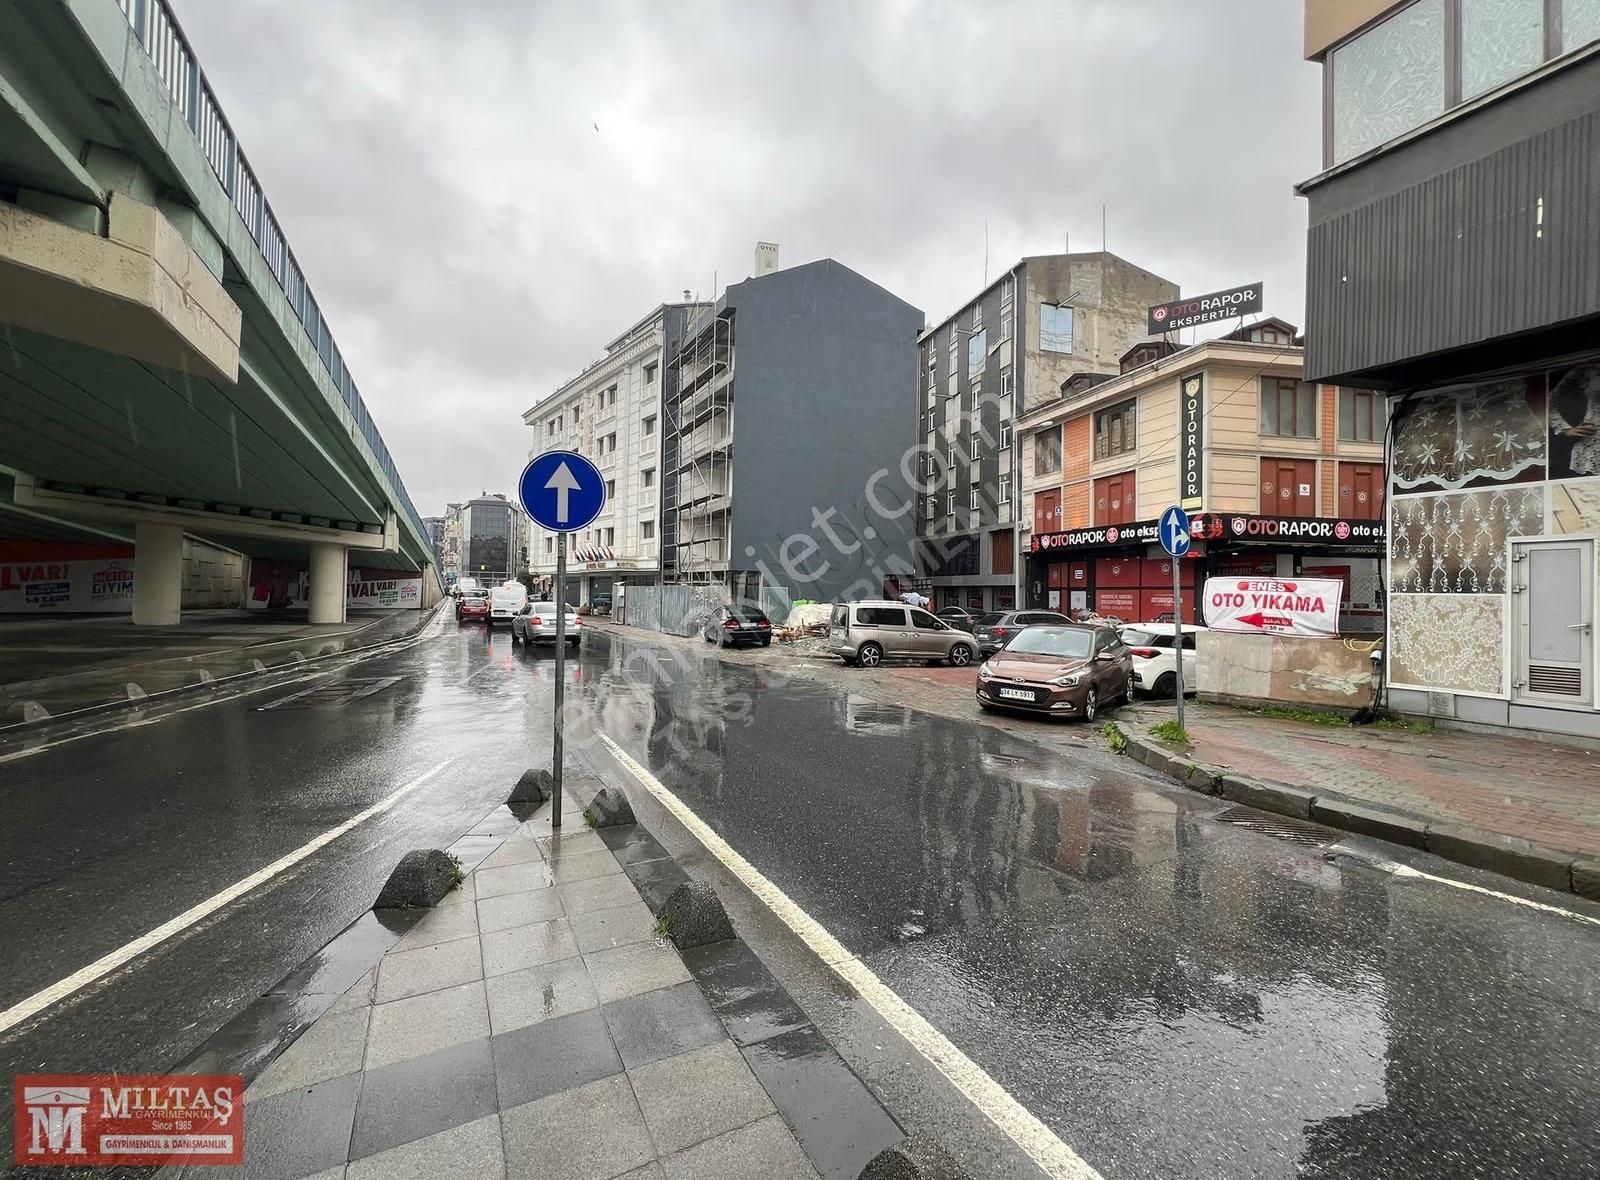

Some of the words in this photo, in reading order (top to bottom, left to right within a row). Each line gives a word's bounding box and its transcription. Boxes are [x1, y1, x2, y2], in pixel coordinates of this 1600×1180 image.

[1171, 290, 1257, 317] OTORAPOR
[1169, 307, 1238, 328] EKSPERTİZ
[1187, 399, 1198, 495] OTORAPOR
[1120, 528, 1136, 539] oto
[1247, 519, 1333, 537] OTORAPOR
[1353, 525, 1369, 536] oto
[1050, 530, 1106, 548] OTORAPOR
[17, 565, 70, 583] VAR!
[376, 581, 397, 591] VAR!
[1248, 582, 1286, 592] ENES
[1212, 593, 1245, 608] OTO
[1251, 593, 1326, 613] YIKAMA
